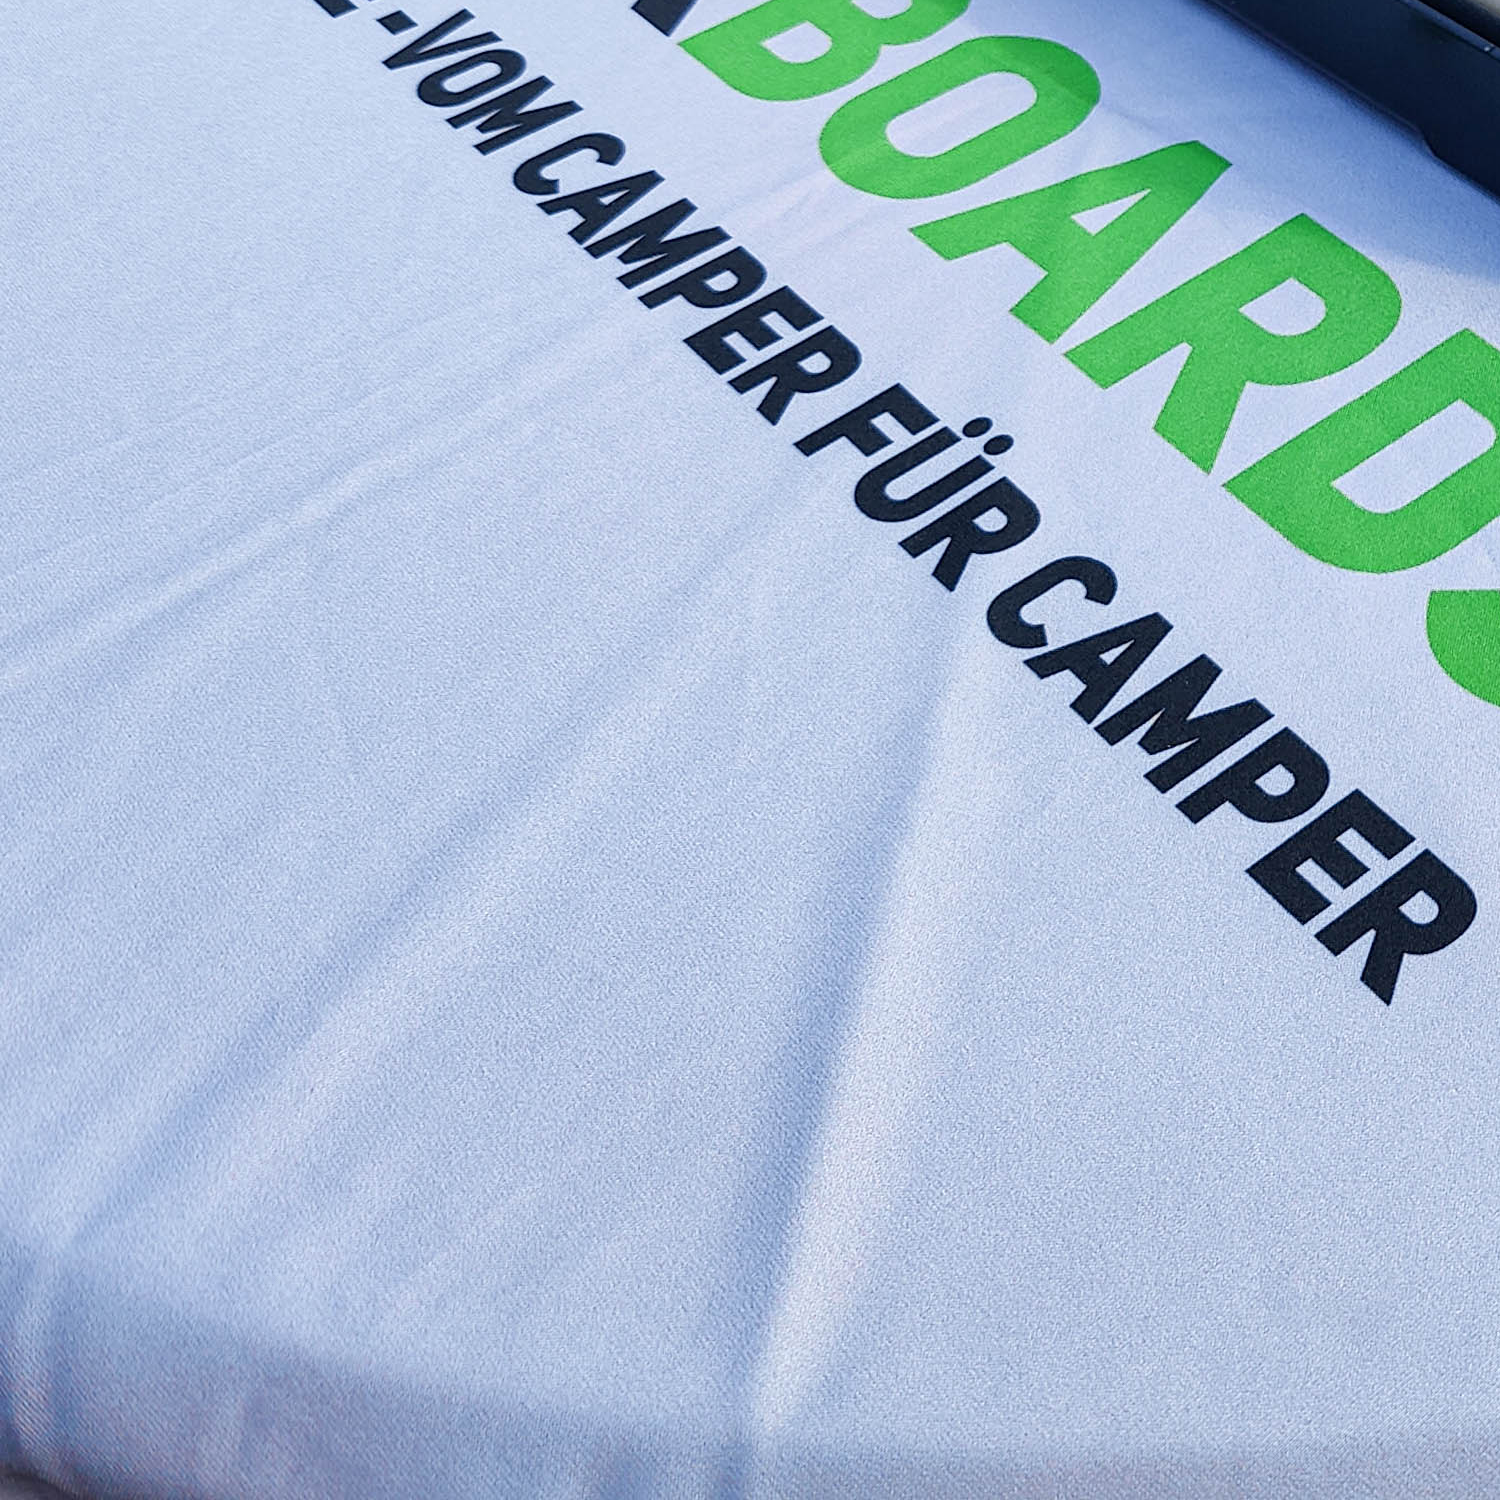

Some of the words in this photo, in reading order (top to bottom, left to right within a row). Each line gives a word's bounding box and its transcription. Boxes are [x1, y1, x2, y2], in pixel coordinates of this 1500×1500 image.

[382, 8, 584, 155] VOM
[513, 132, 862, 426] CAMPER
[793, 383, 1041, 592] FÜR
[987, 555, 1478, 1006] CAMPER
